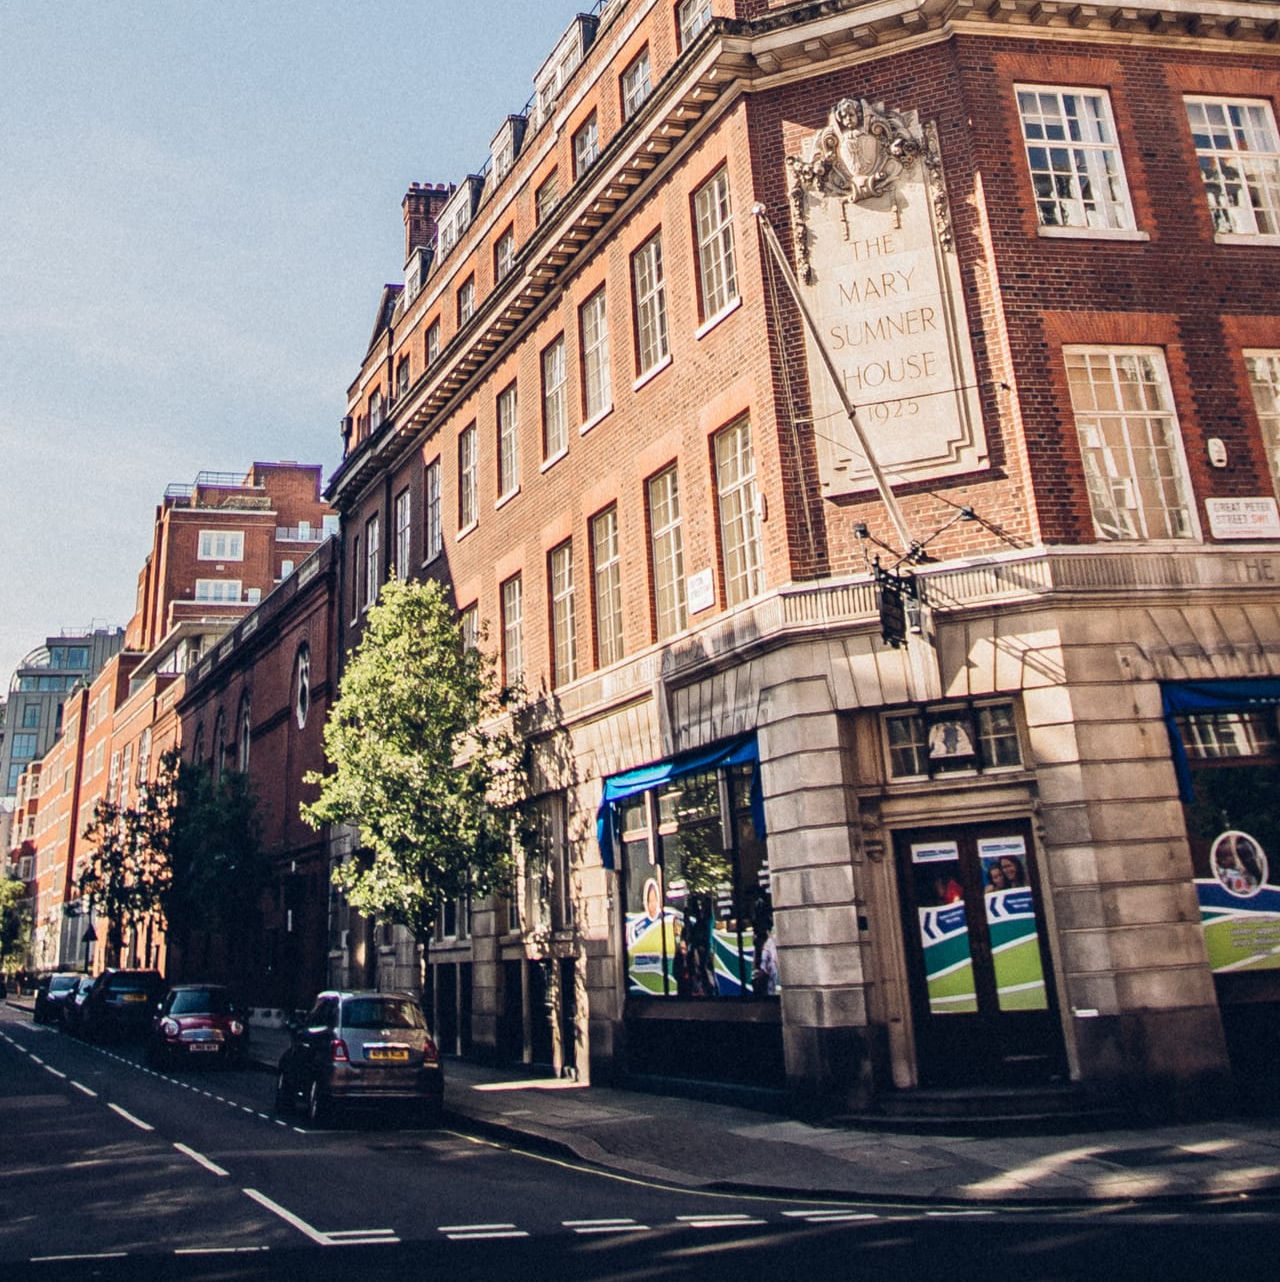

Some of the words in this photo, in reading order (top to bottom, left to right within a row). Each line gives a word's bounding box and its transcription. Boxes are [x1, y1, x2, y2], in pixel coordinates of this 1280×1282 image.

[851, 233, 896, 261] THE
[838, 267, 916, 307] MARY
[830, 306, 938, 351] SUMNER
[842, 351, 937, 392] HOUSE
[868, 401, 920, 425] 1925
[1228, 557, 1275, 583] THE
